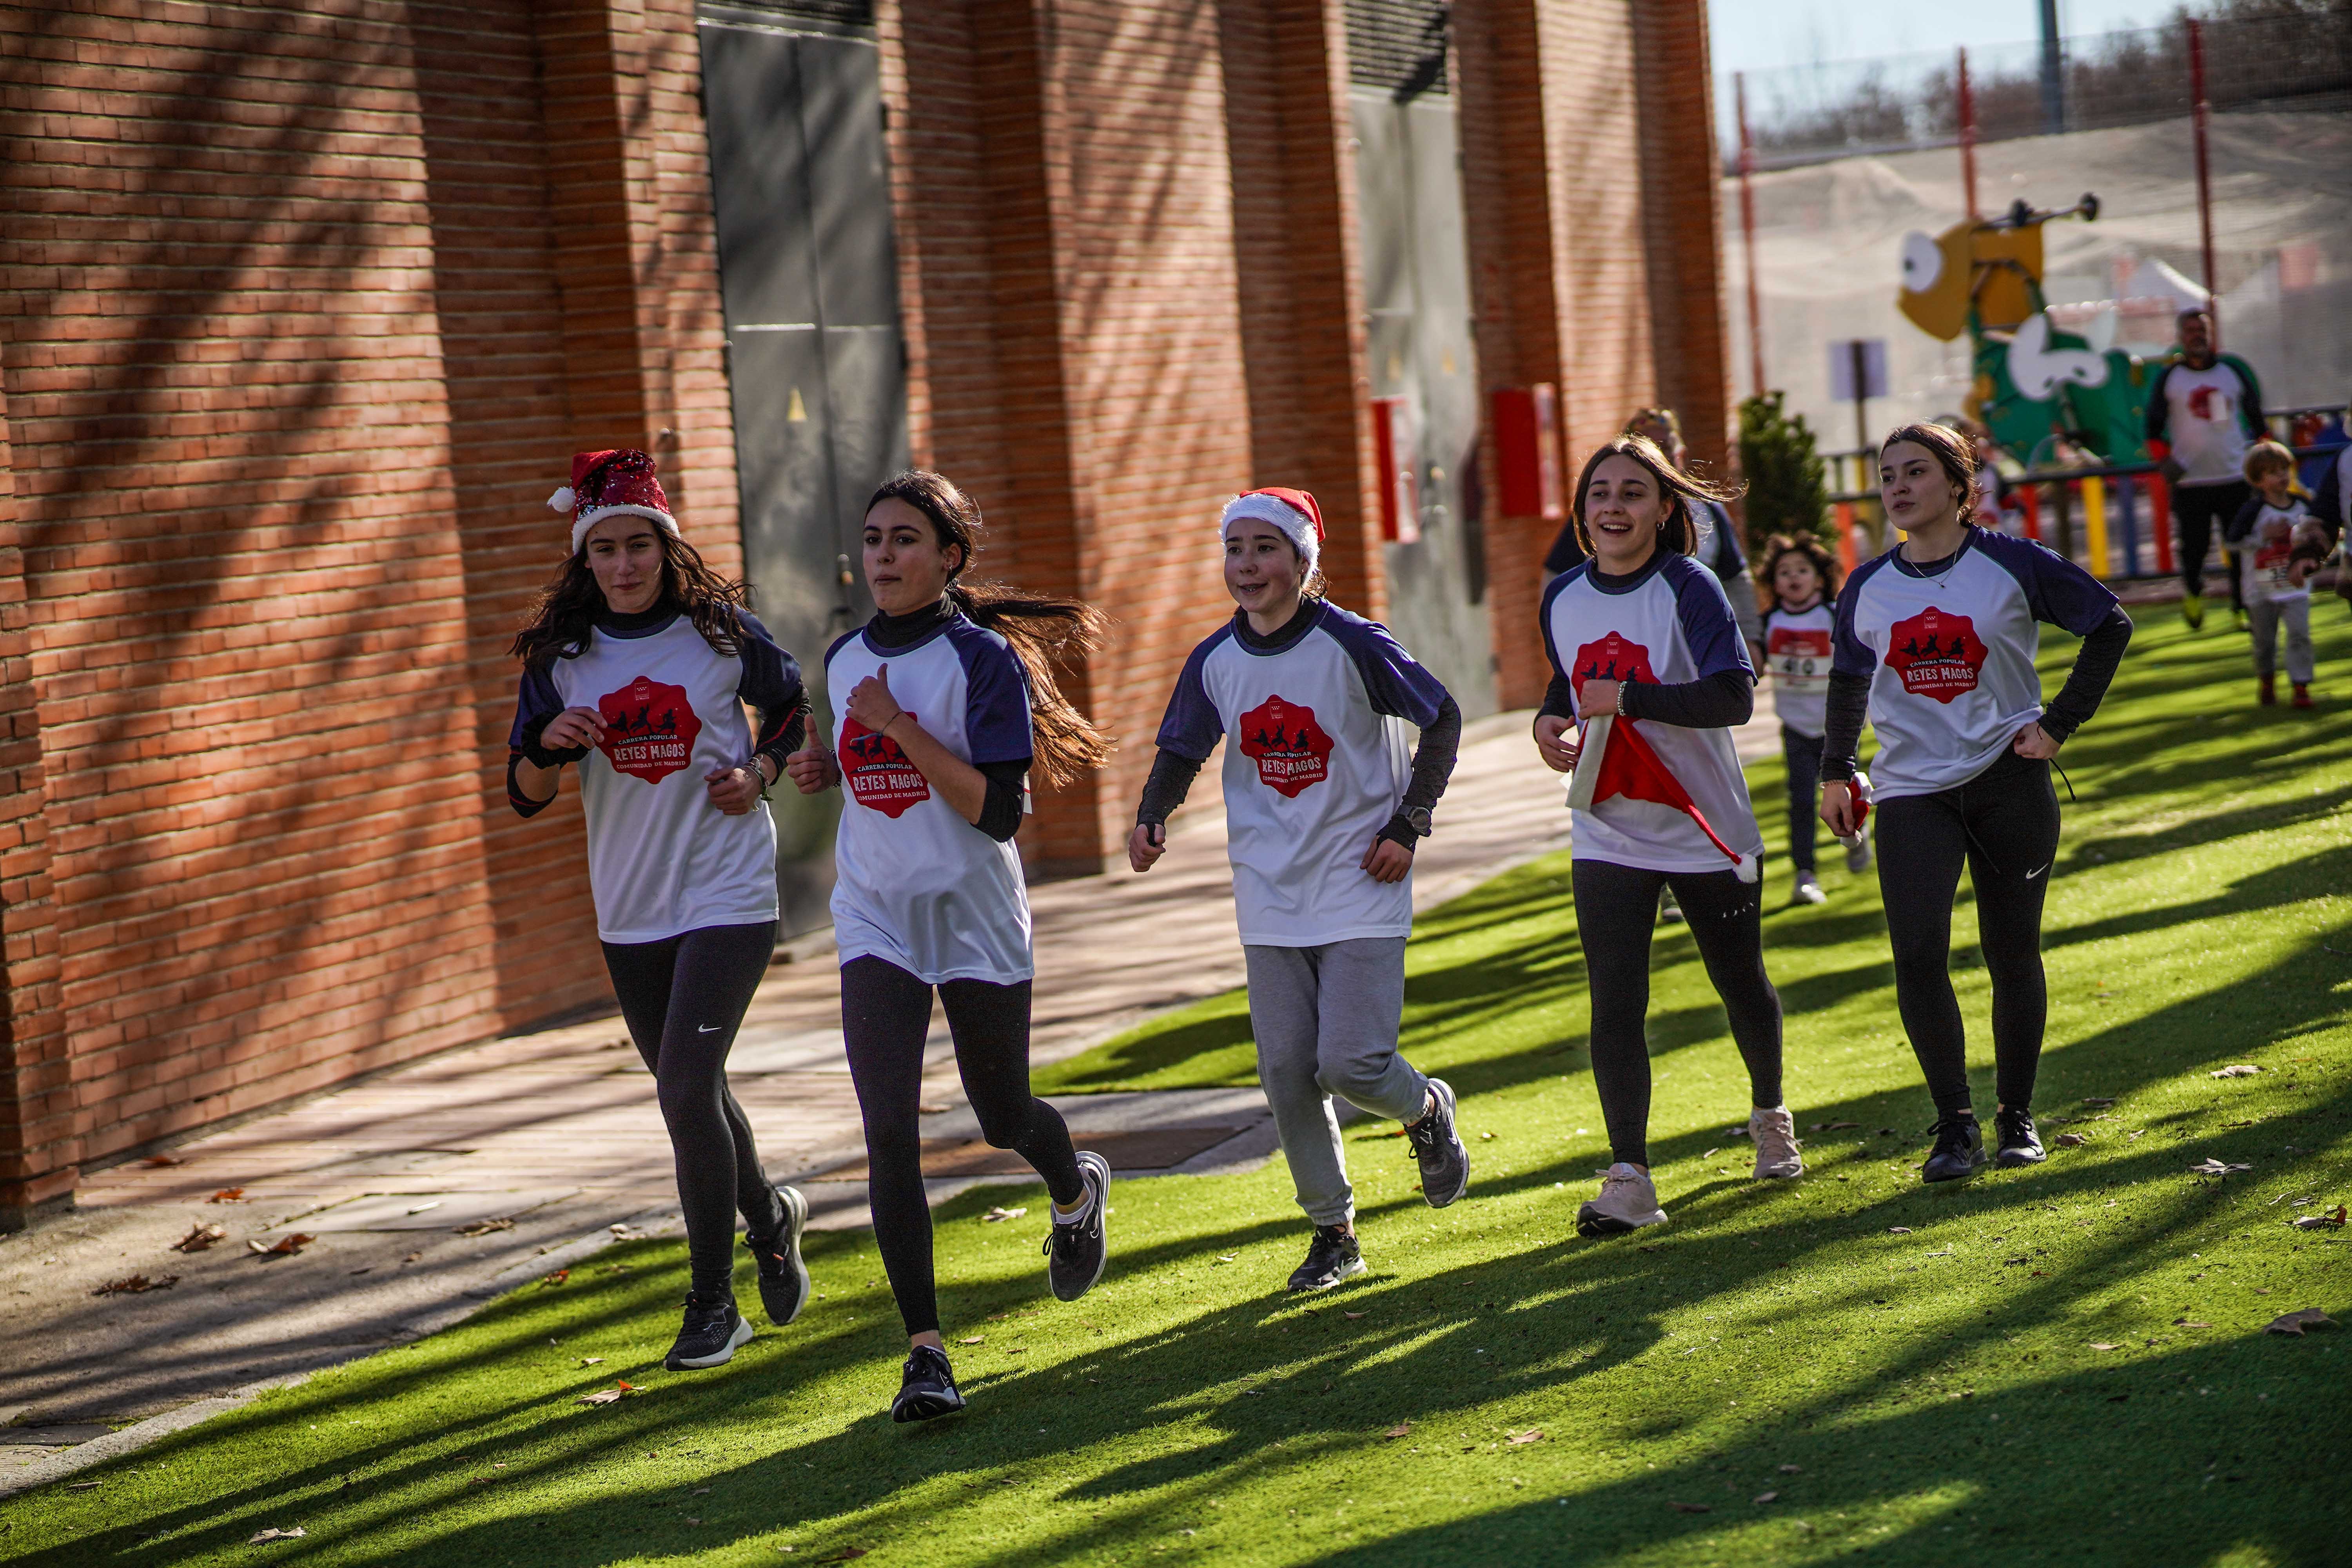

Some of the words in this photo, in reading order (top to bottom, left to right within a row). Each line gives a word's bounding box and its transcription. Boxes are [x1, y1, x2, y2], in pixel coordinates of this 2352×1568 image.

[1907, 668, 1938, 682] REYES
[1941, 667, 1974, 680] MAGOS
[618, 736, 648, 744] CARRERA
[613, 746, 646, 761] REYES
[650, 743, 685, 759] MAGOS
[857, 764, 885, 772] CARRERA
[1261, 759, 1285, 775] REYES
[1287, 757, 1321, 775] MAGOS
[853, 775, 886, 791] REYES
[888, 774, 923, 789] MAGOS
